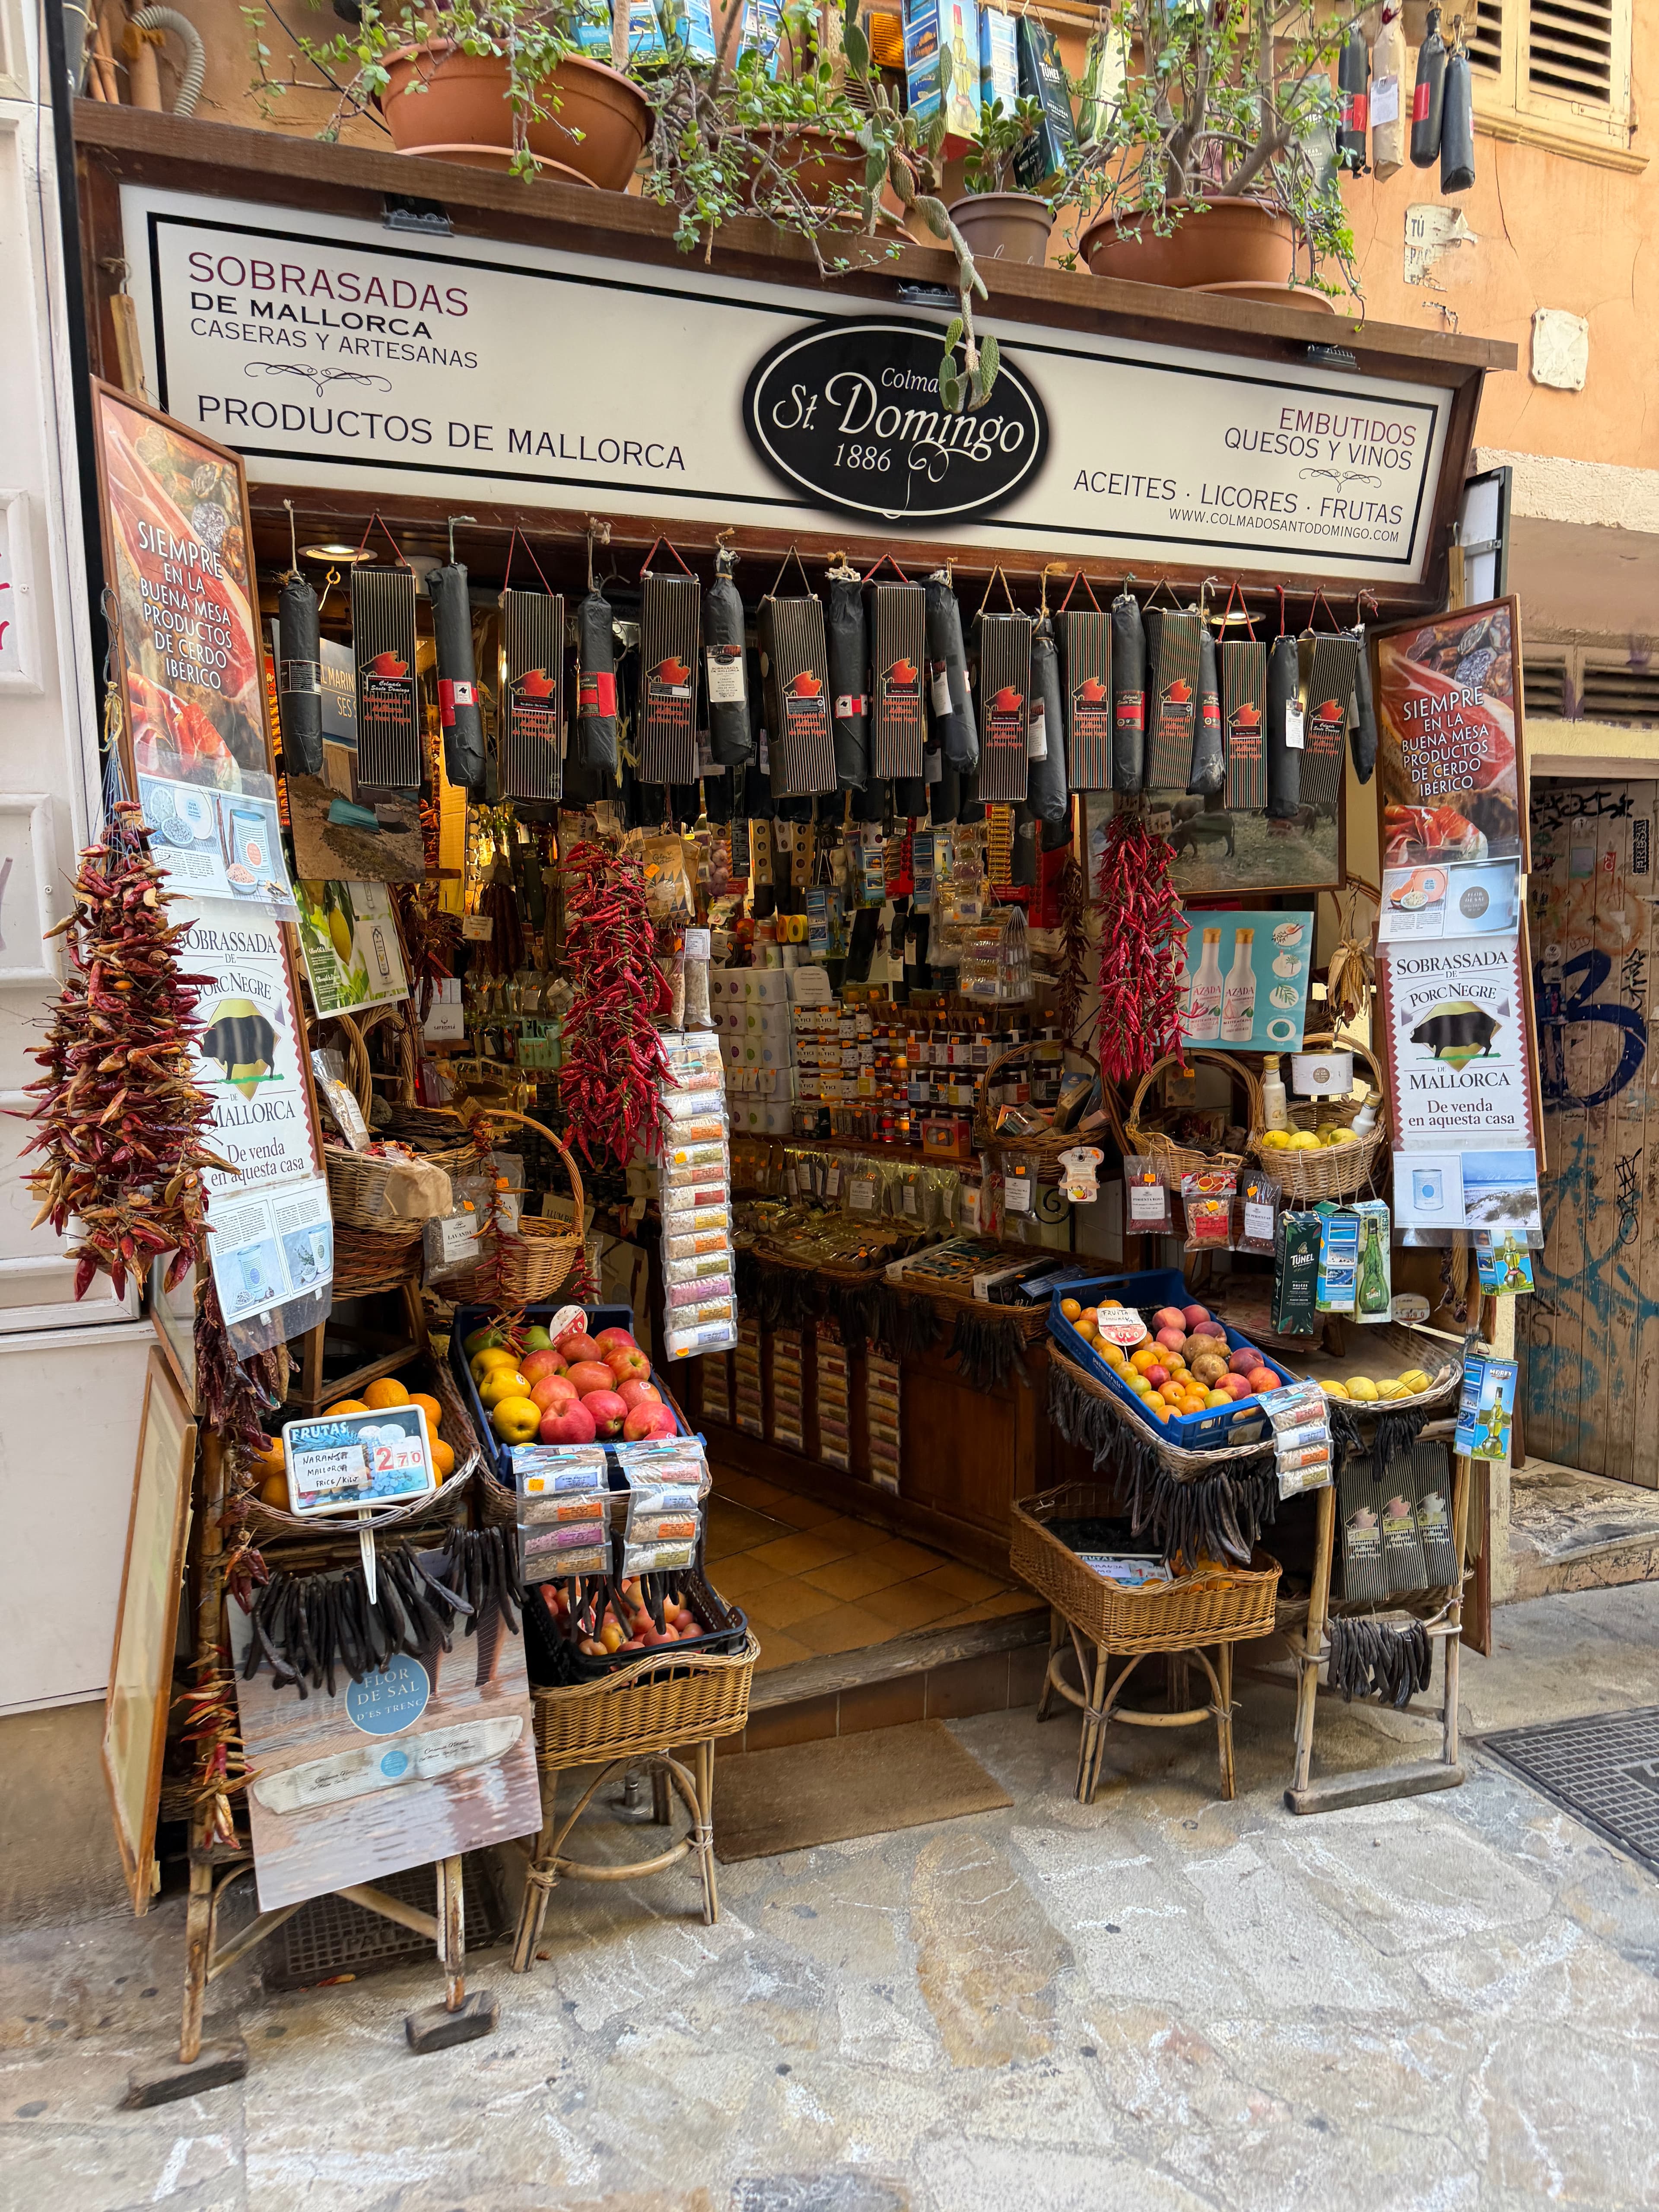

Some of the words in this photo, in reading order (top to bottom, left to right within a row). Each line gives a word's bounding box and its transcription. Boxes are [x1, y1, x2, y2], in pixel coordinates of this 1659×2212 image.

[1411, 215, 1424, 238] TÚ
[189, 252, 469, 317] SOBRASADAS
[191, 292, 237, 315] DE
[251, 299, 432, 340] MALLORCA
[191, 318, 307, 348] CASERAS
[315, 332, 330, 350] Y
[339, 336, 478, 369] ARTESANAS
[882, 367, 940, 393] Colma
[772, 384, 814, 431] St.
[825, 372, 1024, 463] Domingo
[1279, 407, 1417, 447] EMBUTIDOS
[198, 394, 432, 445] PRODUCTOS
[448, 421, 493, 451] DE
[508, 428, 686, 471] MALLORCA
[834, 442, 892, 472] 1886
[1224, 427, 1319, 459] QUESOS
[1328, 440, 1341, 461] Y
[1348, 442, 1412, 471] VINOS
[1073, 469, 1177, 501] ACEITES
[1201, 483, 1299, 514] LICORES
[1319, 496, 1404, 525] FRUTAS
[1169, 508, 1399, 542] WWW.COLMADOSANTODOMINGO.COM
[137, 521, 223, 579] SIEMPRE
[164, 562, 183, 586] EN
[188, 571, 206, 595] LA
[140, 577, 190, 613] BUENA
[194, 597, 231, 626] MESA
[143, 603, 232, 648] PRODUCTOS
[154, 629, 174, 654] DE
[178, 639, 226, 669] CERDO
[166, 657, 221, 690] IBÉRICO
[337, 696, 351, 718] SES
[1403, 686, 1484, 721] SIEMPRE
[1424, 716, 1441, 732] EN
[1447, 712, 1464, 728] LA
[1402, 732, 1447, 753] BUENA
[1452, 724, 1489, 743] MESA
[1403, 739, 1488, 769] PRODUCTOS
[1411, 767, 1428, 782] DE
[1433, 758, 1481, 778] CERDO
[1420, 775, 1473, 797] IBÉRICO
[225, 953, 236, 963] DE
[1396, 950, 1509, 976] SOBRASSADA
[229, 972, 272, 1000] NEGRE
[1446, 970, 1458, 979] DE
[1193, 986, 1221, 996] AZADA
[1225, 986, 1254, 997] AZADA
[1408, 986, 1447, 1007] PORC
[1448, 982, 1497, 999] NEGRE
[1409, 1071, 1511, 1090] MALLORCA
[230, 1093, 238, 1102] DE
[1427, 1100, 1449, 1113] De
[1450, 1097, 1493, 1113] venda
[207, 1100, 296, 1130] MALLORCA
[1408, 1116, 1425, 1126] en
[1428, 1113, 1481, 1128] aquesta
[1485, 1113, 1515, 1125] casa
[227, 1144, 247, 1164] De
[248, 1137, 286, 1160] venda
[211, 1171, 227, 1187] en
[230, 1161, 277, 1185] aquesta
[280, 1157, 305, 1171] casa
[448, 1230, 472, 1240] LAVANDA
[1290, 1253, 1315, 1265] TÚNEL
[290, 1421, 346, 1441] FRUTAS
[303, 1452, 348, 1465] NARANJA
[308, 1465, 347, 1477] MALLORCA
[364, 1668, 410, 1689] FLOR
[357, 1690, 381, 1706] DE
[387, 1681, 420, 1698] SAL
[385, 1698, 423, 1714] TRENC
